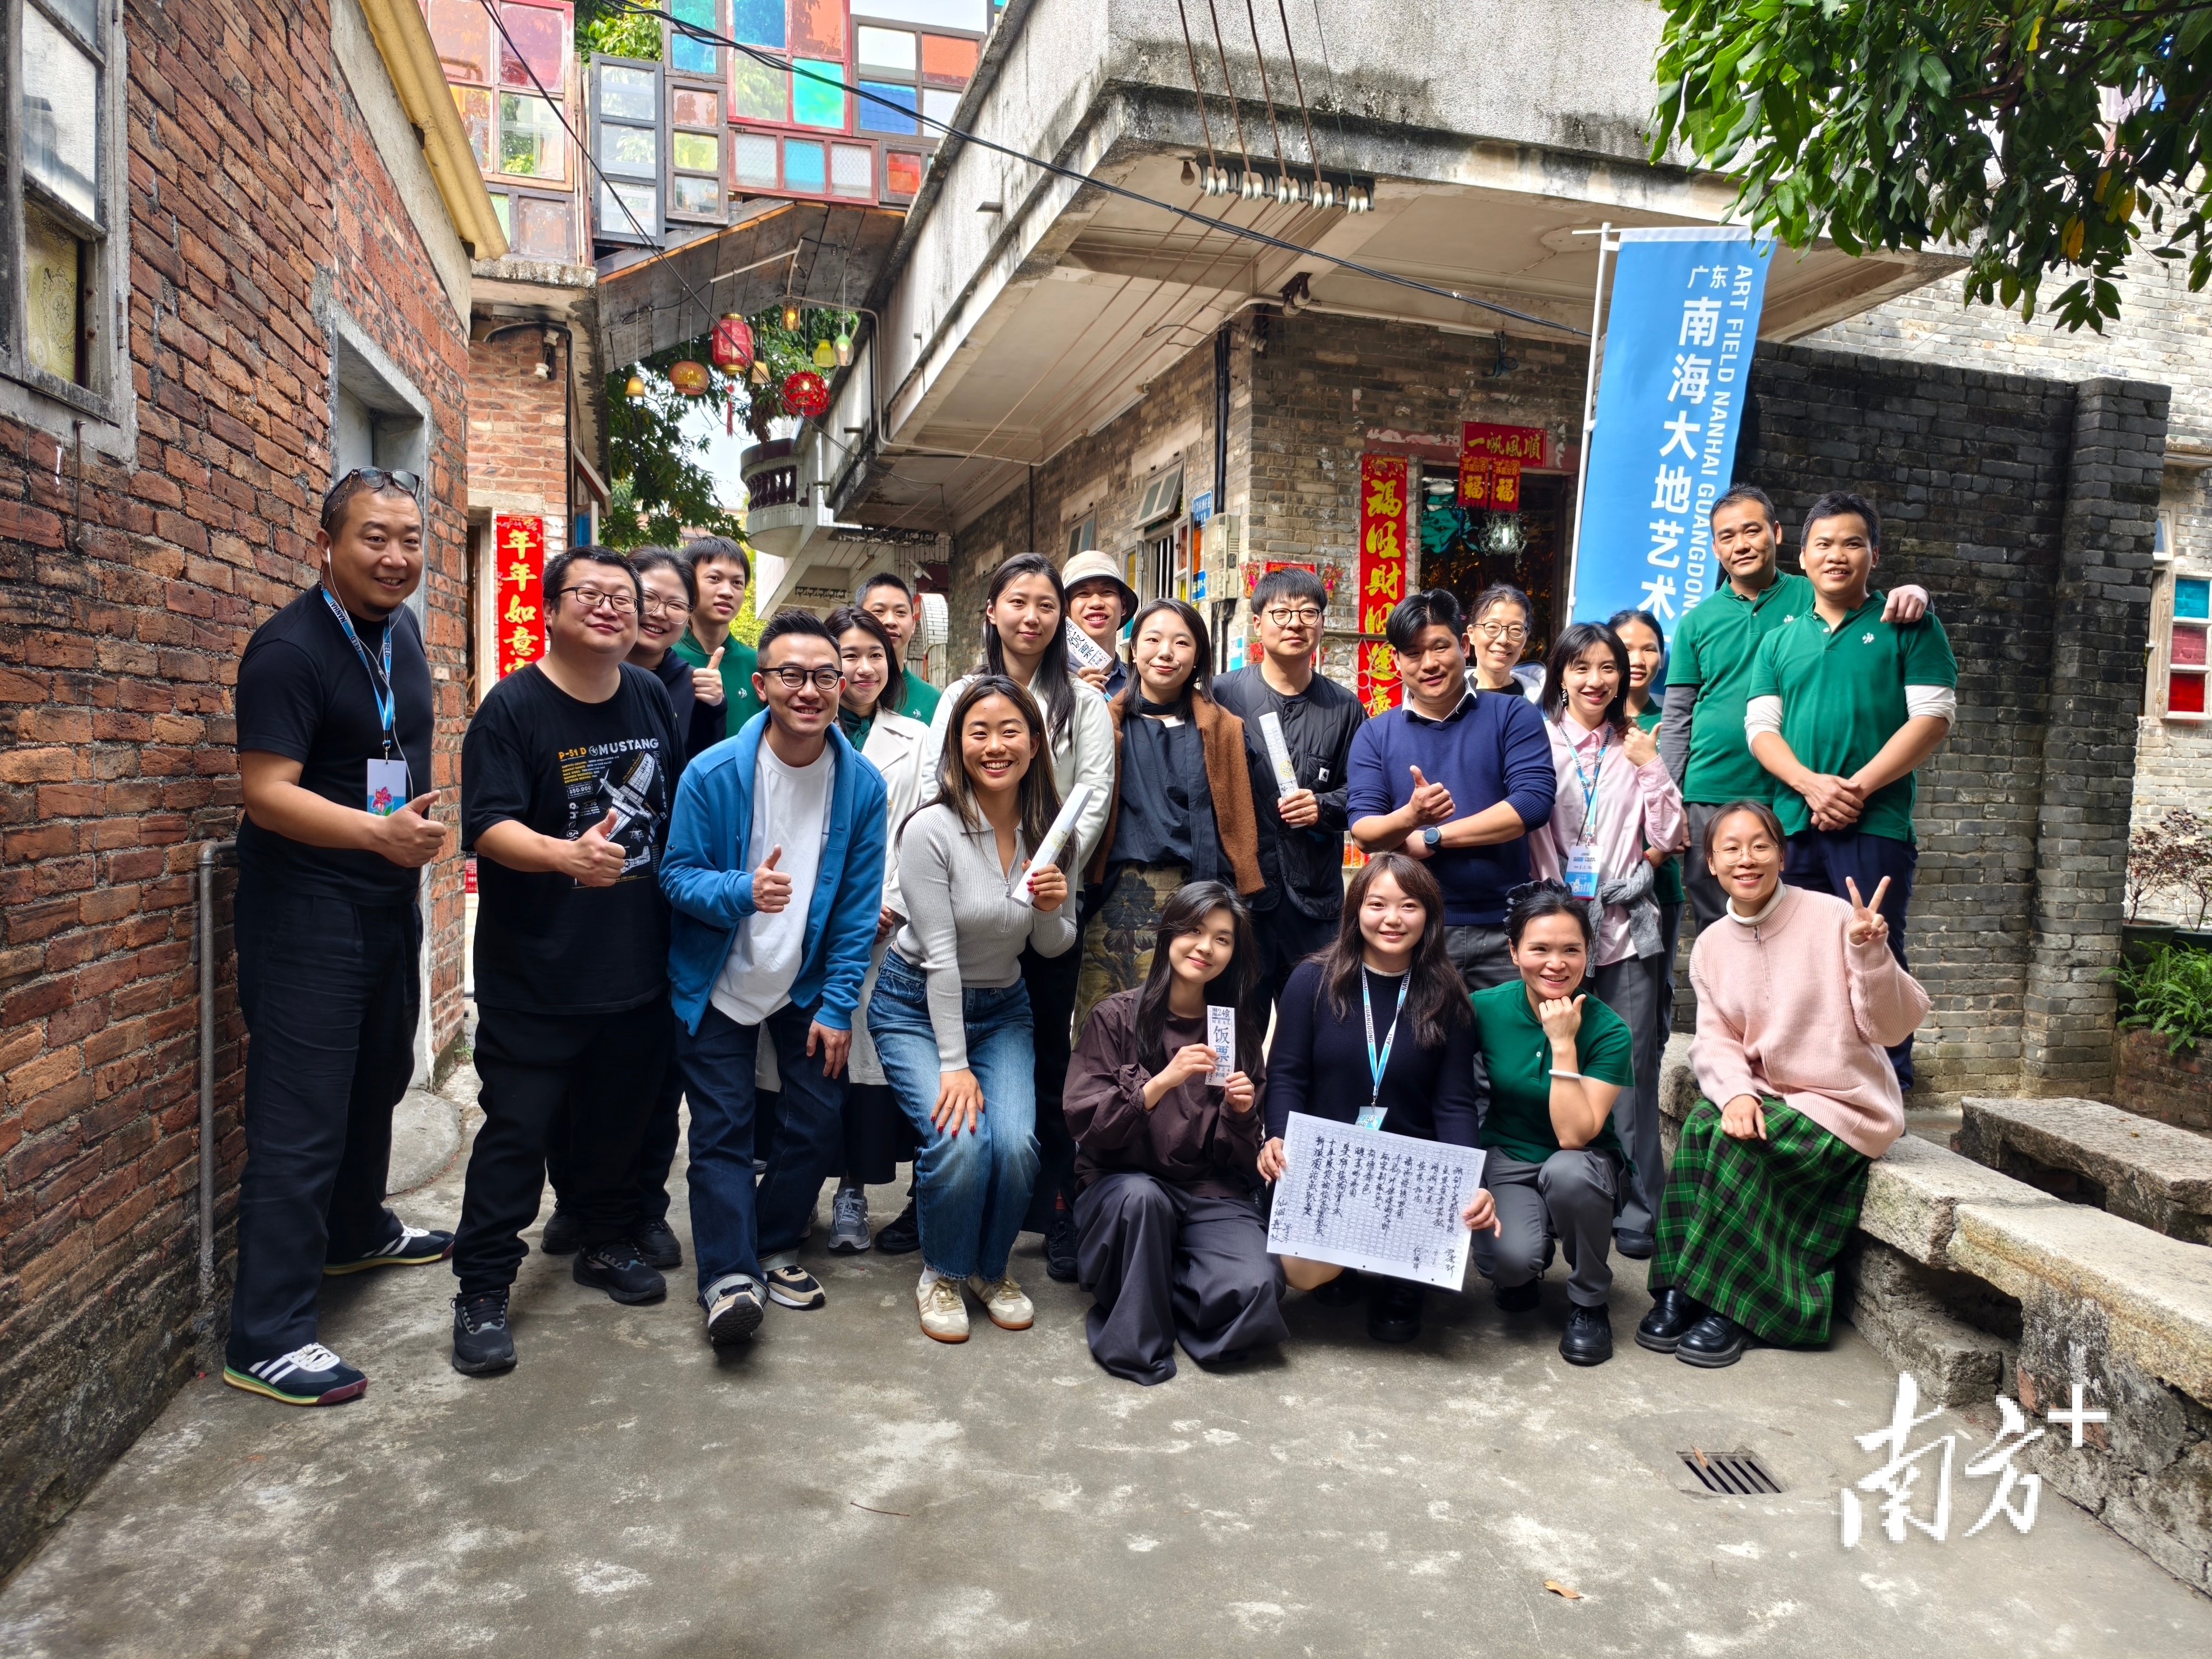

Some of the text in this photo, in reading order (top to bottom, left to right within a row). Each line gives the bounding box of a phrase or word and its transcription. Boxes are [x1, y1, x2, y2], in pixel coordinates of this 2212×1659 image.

[1687, 265, 1729, 289] 广东
[1681, 265, 1754, 617] ART FIELD NANHAI GUANGDON
[1637, 296, 1722, 643] 南海大地艺术
[1464, 475, 1483, 499] 福
[1496, 478, 1515, 502] 福
[329, 601, 347, 624] NANHAI
[351, 636, 362, 653] FIELD
[580, 747, 587, 755] D
[599, 738, 659, 756] MUSTANG
[1402, 968, 1411, 991] NANHA
[1365, 1004, 1374, 1043] GUANGDONG
[1213, 1026, 1230, 1063] 饭票
